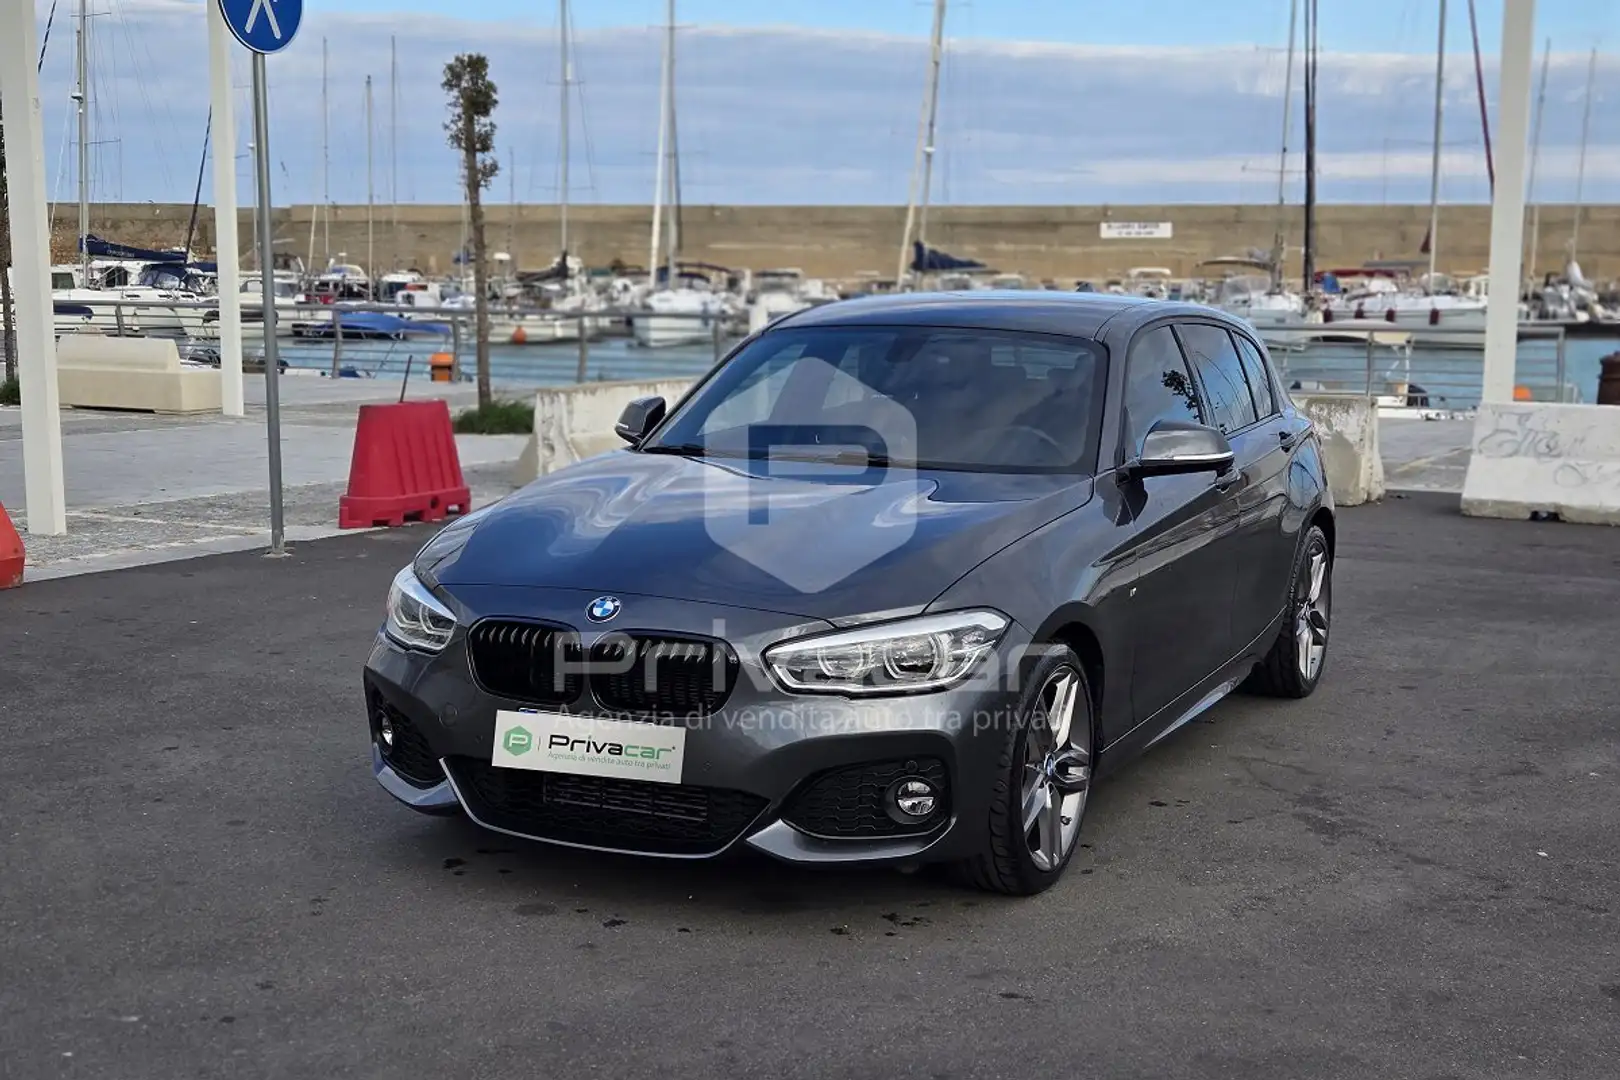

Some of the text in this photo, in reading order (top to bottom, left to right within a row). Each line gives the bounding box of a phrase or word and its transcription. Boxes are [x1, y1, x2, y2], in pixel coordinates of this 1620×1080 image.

[548, 734, 674, 760] Privacar
[616, 758, 633, 767] auto
[634, 760, 645, 768] tra
